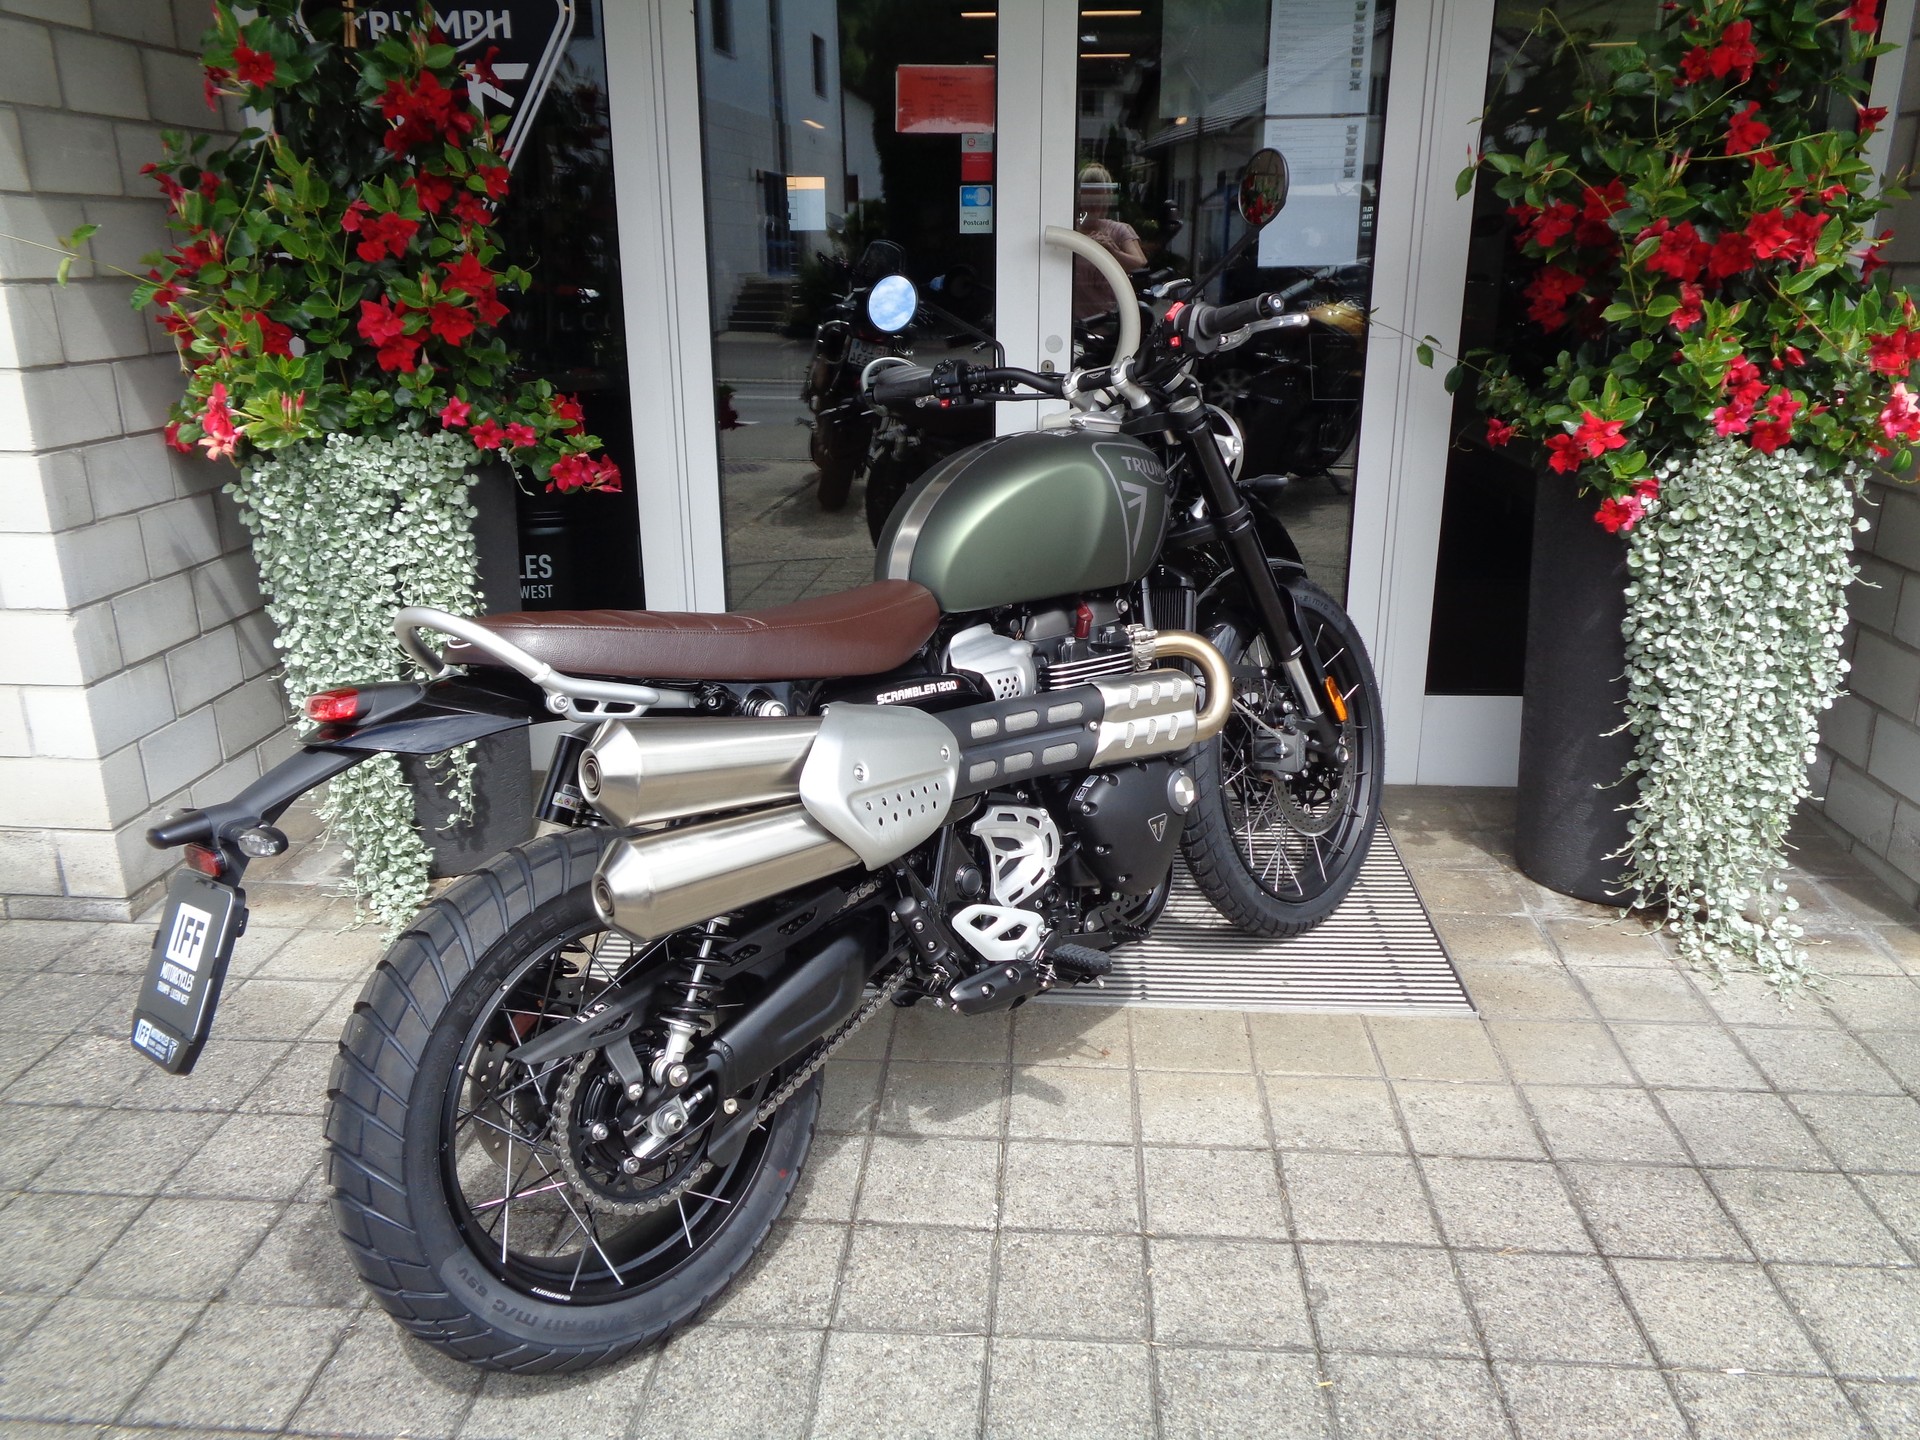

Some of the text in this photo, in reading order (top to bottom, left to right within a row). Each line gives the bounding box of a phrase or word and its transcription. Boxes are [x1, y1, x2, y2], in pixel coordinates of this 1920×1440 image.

[963, 219, 990, 227] Postcard
[520, 584, 554, 599] WEST
[877, 680, 957, 705] SCRAMBLER 1200
[173, 913, 205, 958] IFF
[160, 961, 195, 993] MOTORCYCLES
[137, 1023, 150, 1042] IFF
